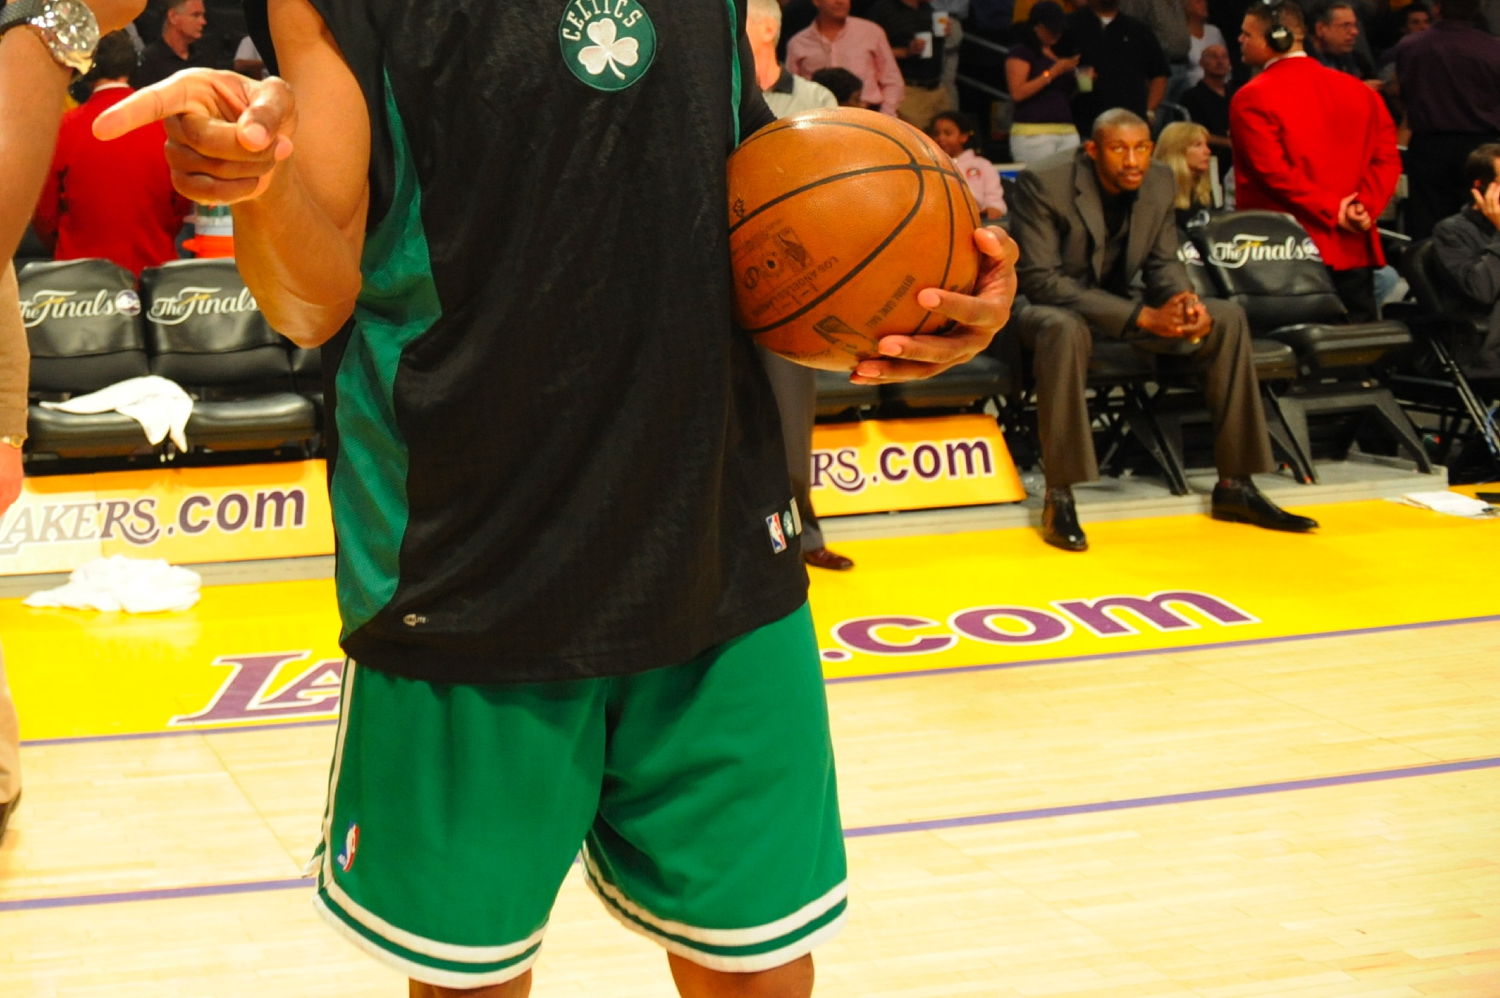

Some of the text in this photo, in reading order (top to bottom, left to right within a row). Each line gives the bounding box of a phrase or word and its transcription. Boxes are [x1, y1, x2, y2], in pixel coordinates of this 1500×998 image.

[1214, 242, 1242, 260] The
[1226, 233, 1304, 268] Finals
[24, 288, 114, 328] Finals
[150, 286, 261, 325] The Finals
